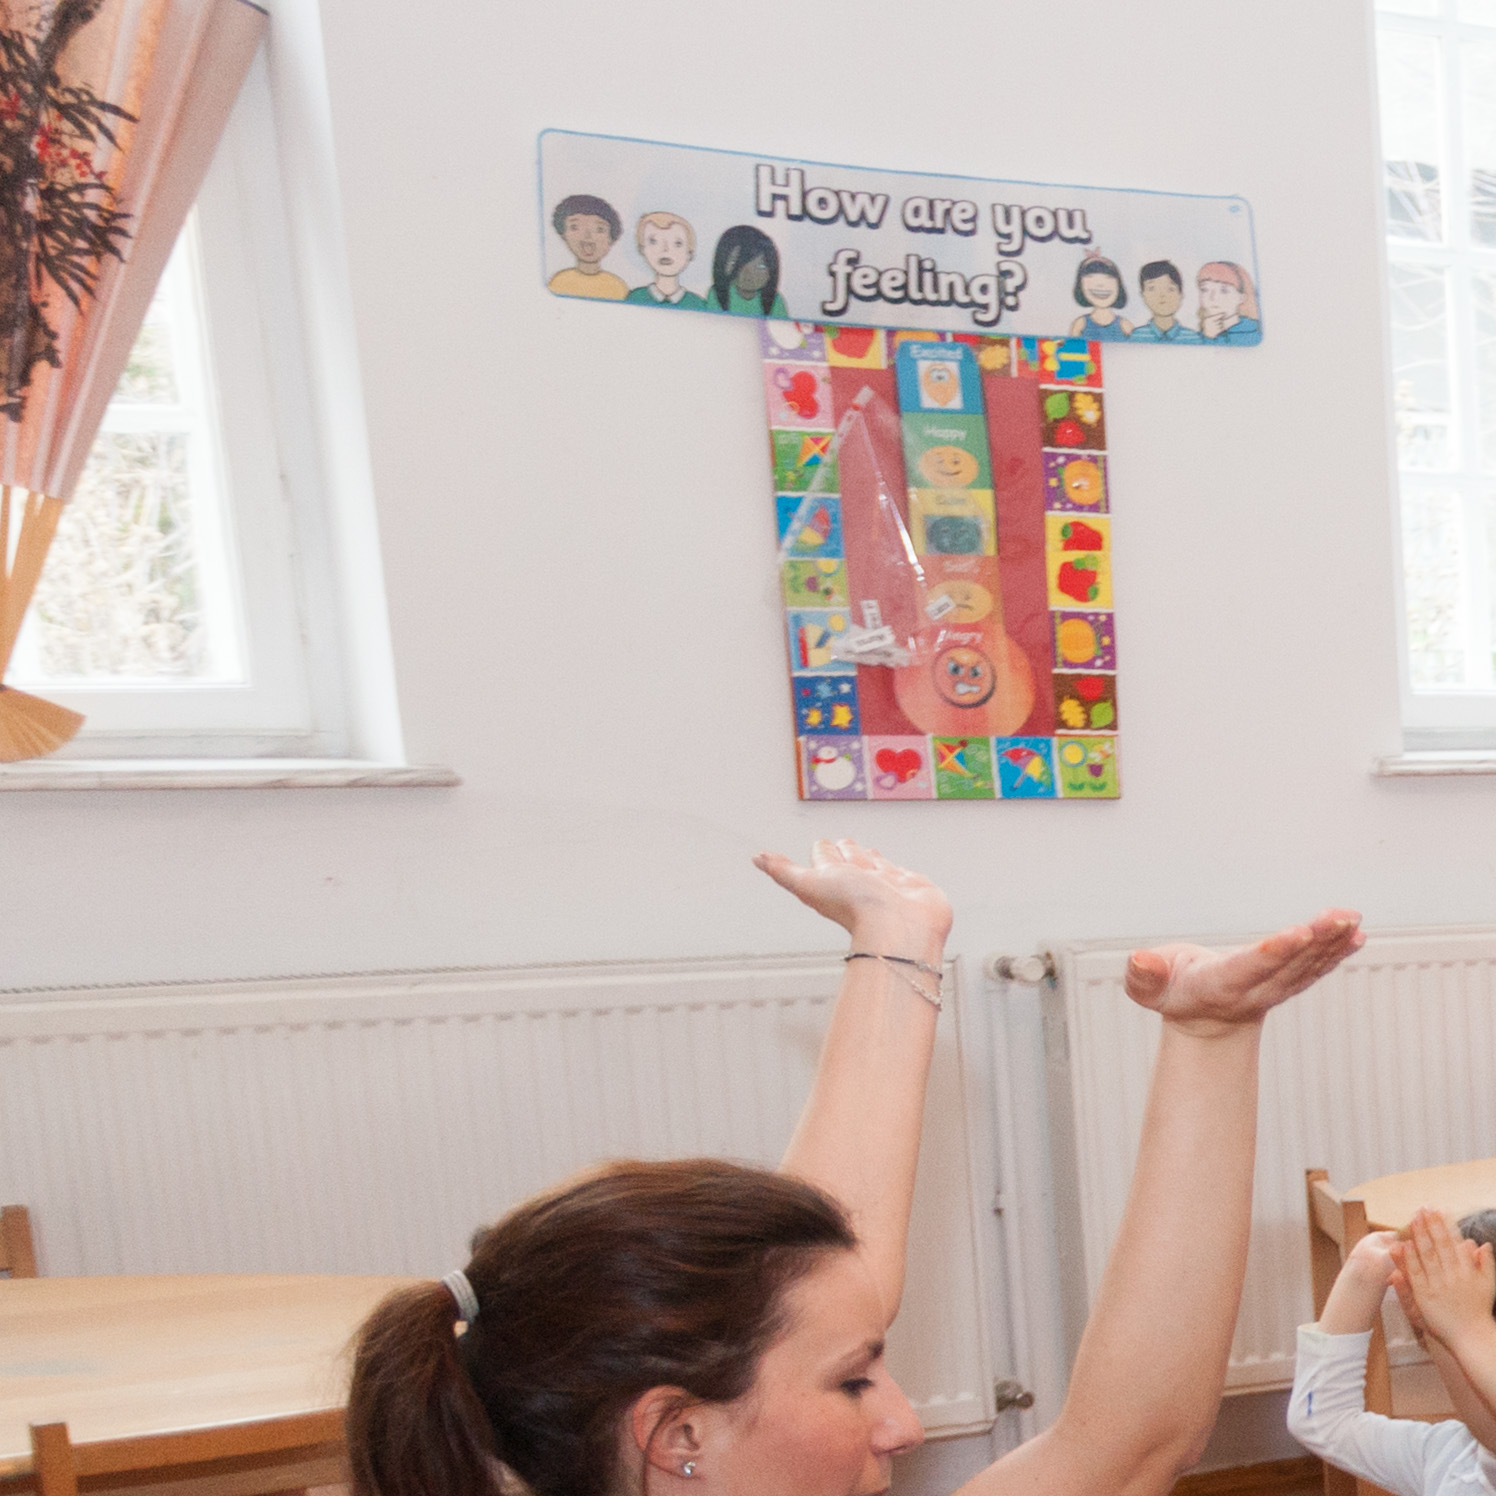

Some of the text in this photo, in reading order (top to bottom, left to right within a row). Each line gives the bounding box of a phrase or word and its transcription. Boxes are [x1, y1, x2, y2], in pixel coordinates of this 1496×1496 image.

[756, 163, 1092, 257] How are you
[821, 248, 1027, 328] feeling?
[909, 344, 964, 360] Excited
[923, 424, 968, 440] Happy
[945, 631, 983, 644] Angry
